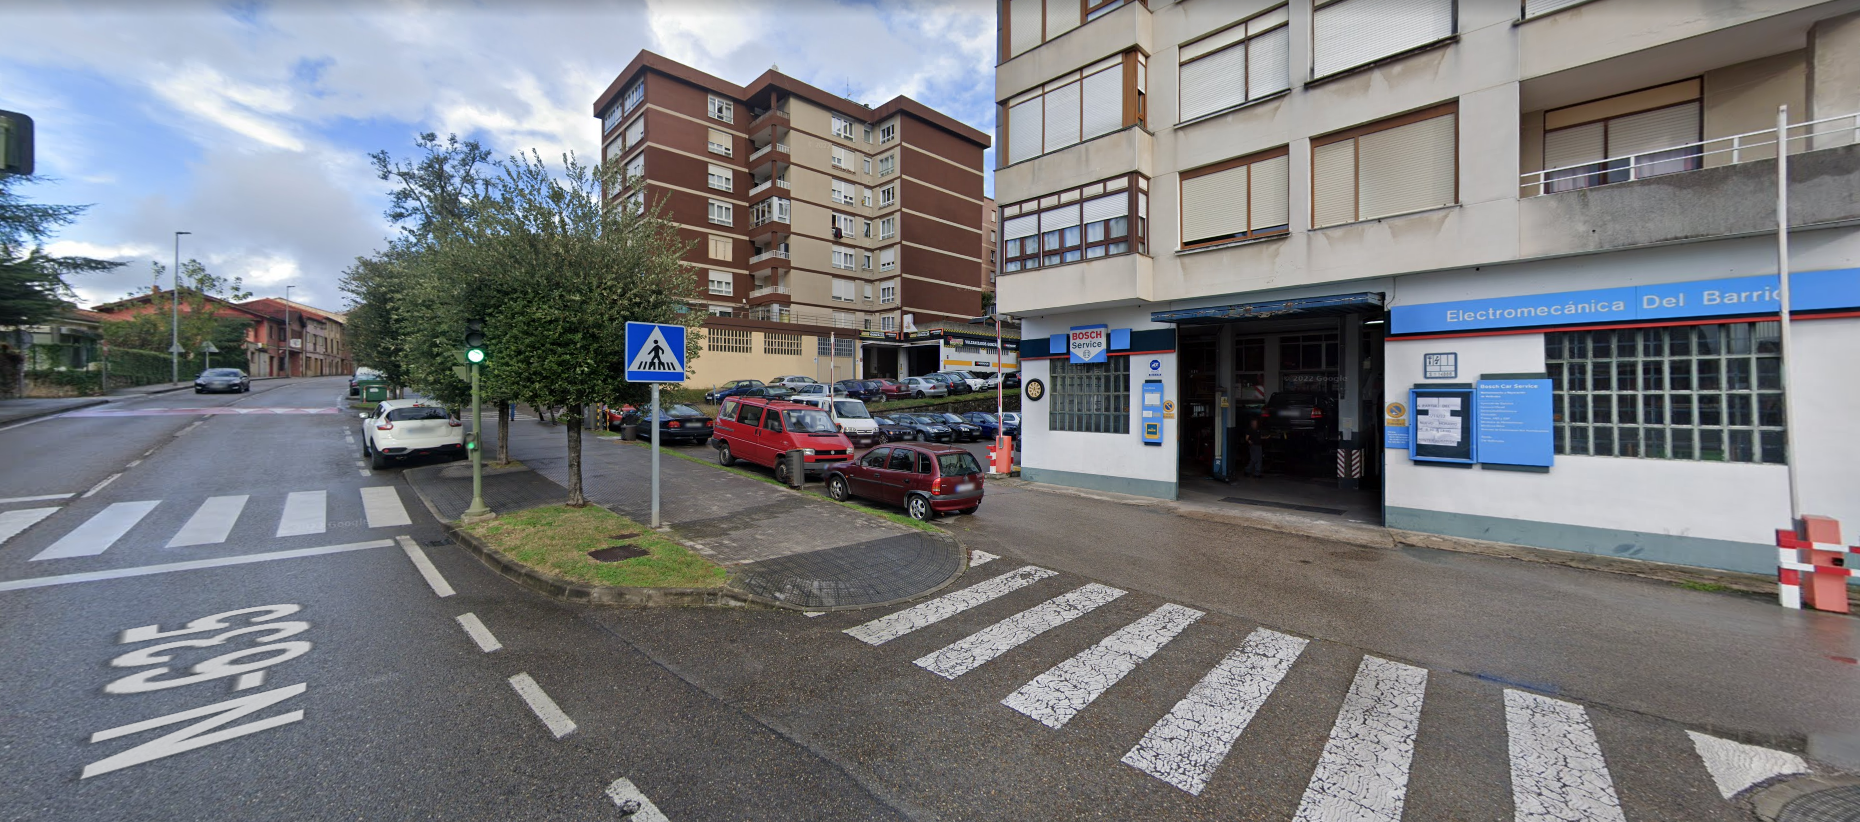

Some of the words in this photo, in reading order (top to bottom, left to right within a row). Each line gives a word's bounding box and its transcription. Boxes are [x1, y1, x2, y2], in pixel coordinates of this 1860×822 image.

[1446, 300, 1625, 322] Electromecánica
[1642, 292, 1684, 309] Del
[1072, 331, 1102, 340] BOSCH
[1072, 340, 1102, 349] Service
[81, 603, 312, 780] N-635
